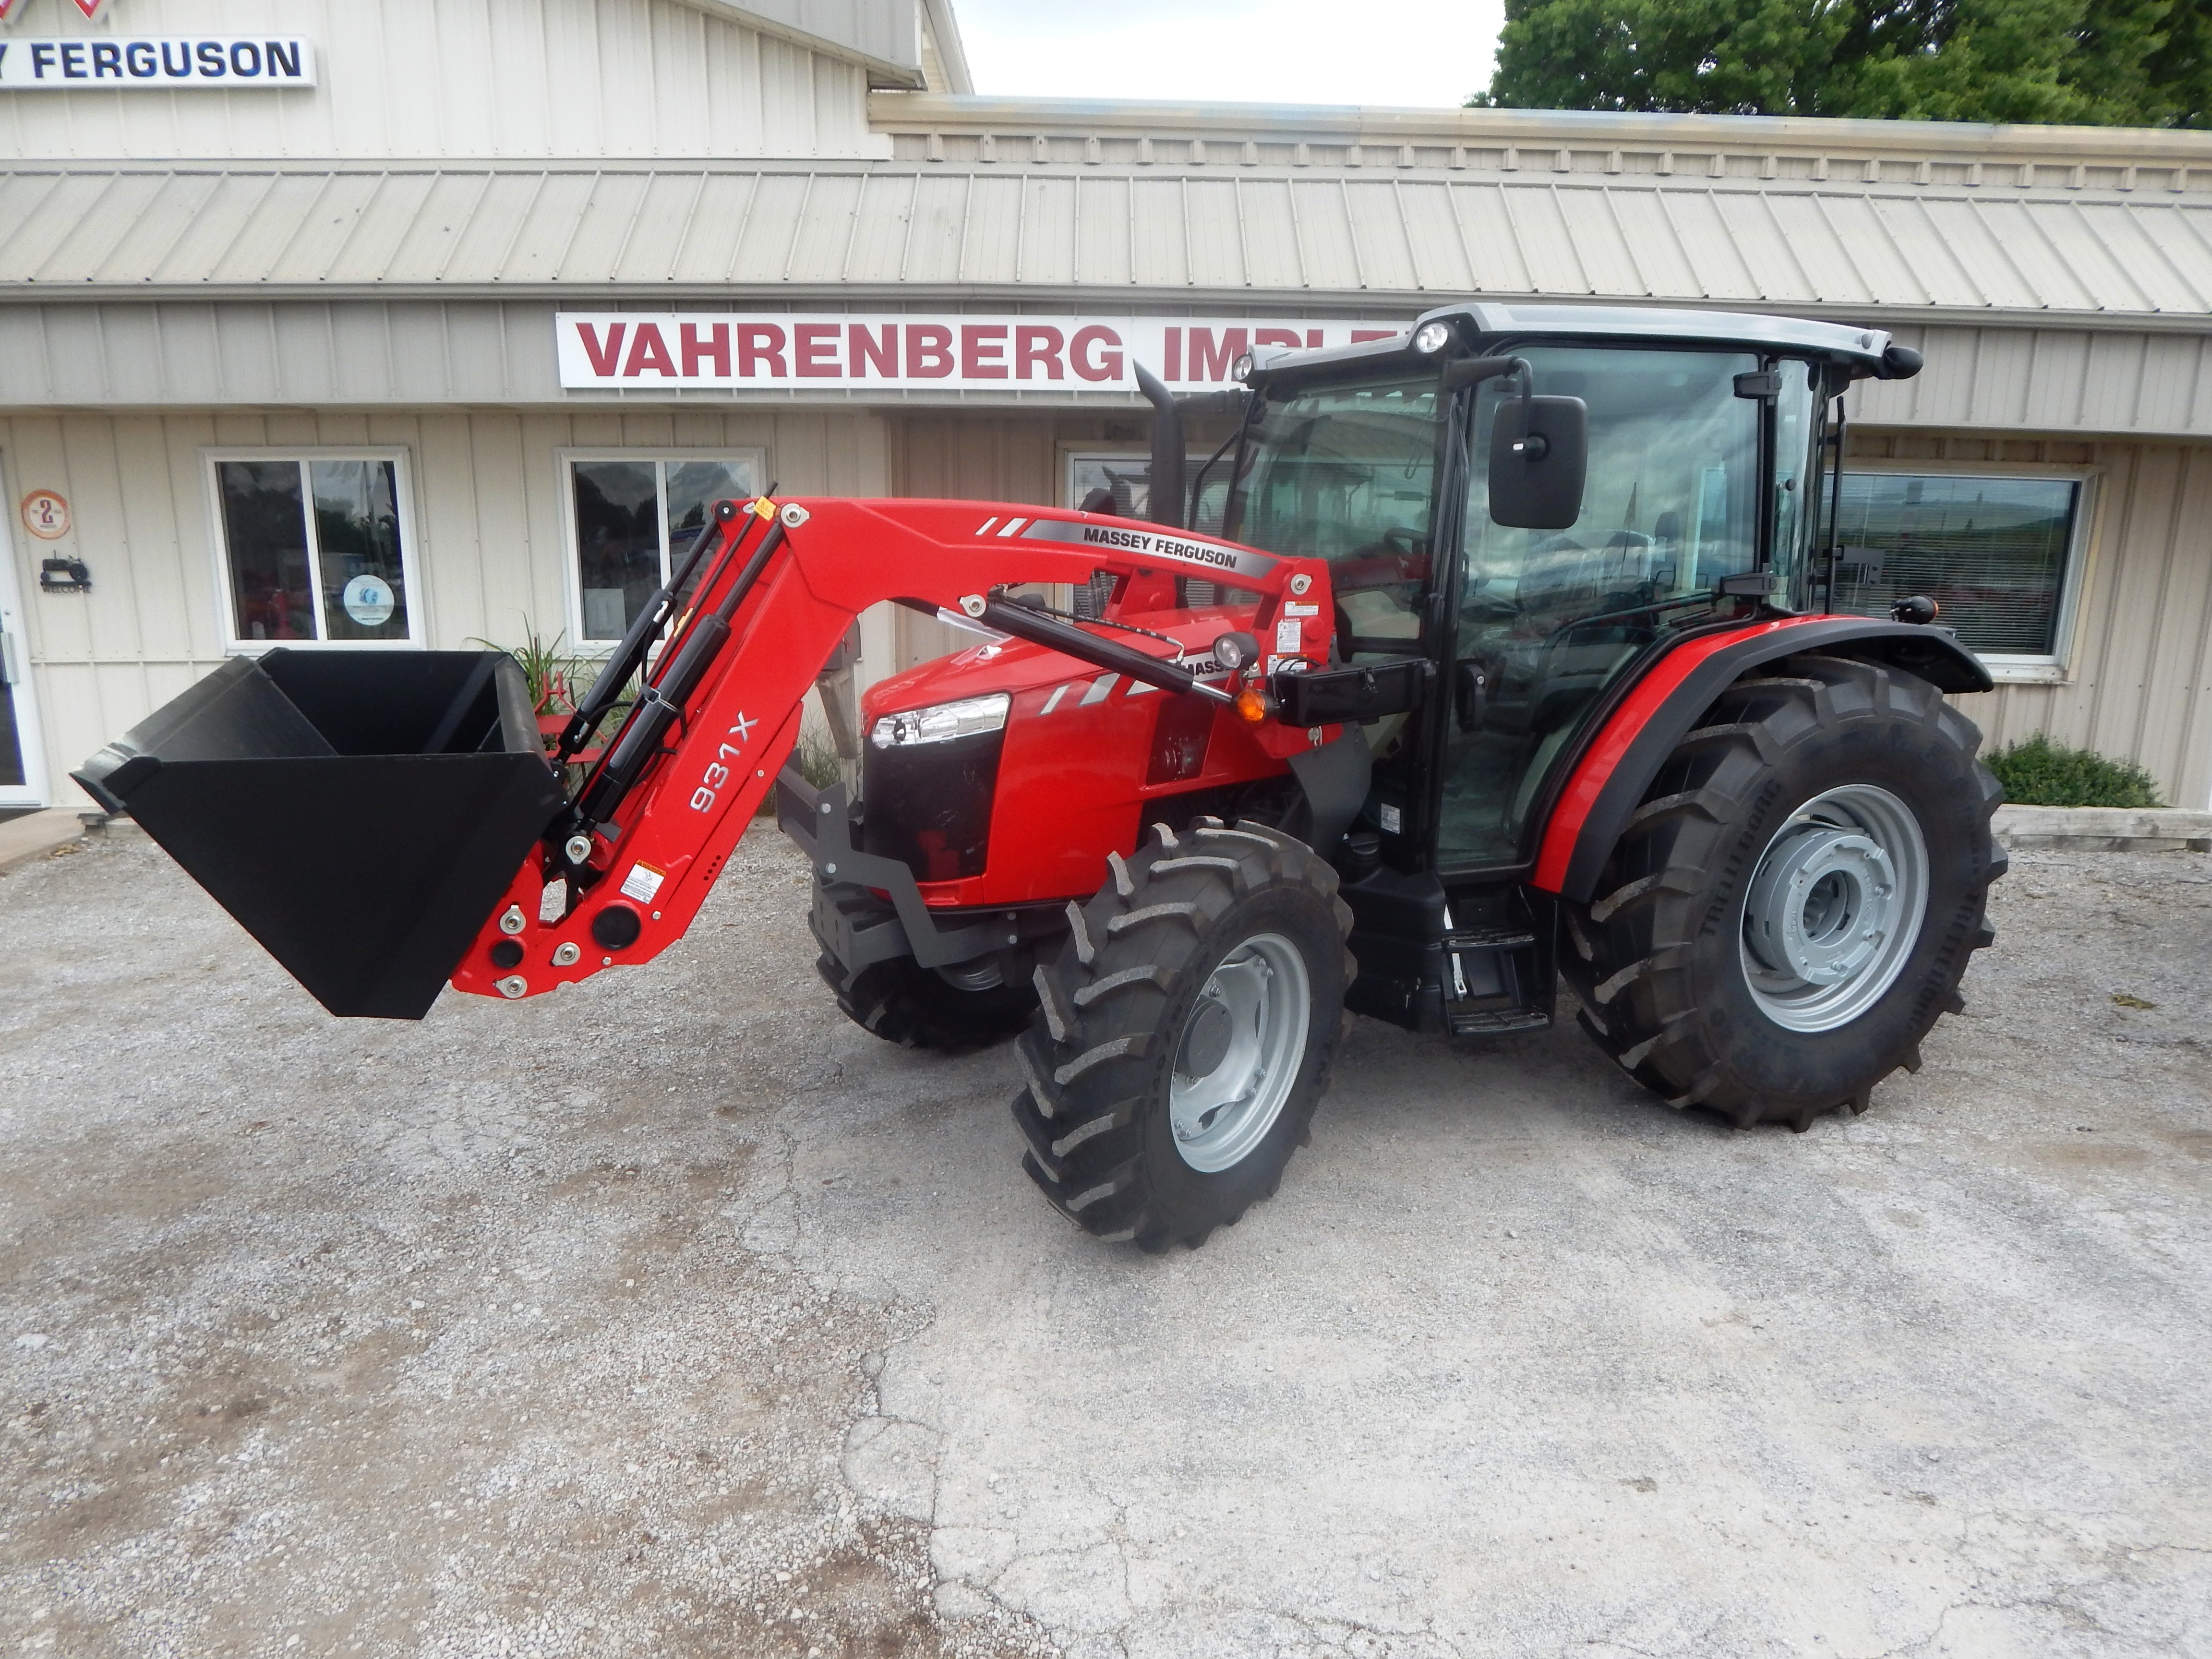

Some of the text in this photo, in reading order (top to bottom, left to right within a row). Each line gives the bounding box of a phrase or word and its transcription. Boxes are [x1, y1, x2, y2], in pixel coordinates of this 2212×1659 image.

[30, 41, 302, 79] FERGUSON
[575, 323, 1123, 382] VAHRENBERG
[1084, 527, 1238, 569] MASSEY FERGUSON
[41, 584, 92, 593] WELCOME
[1698, 779, 1782, 937] TRELLEBORG
